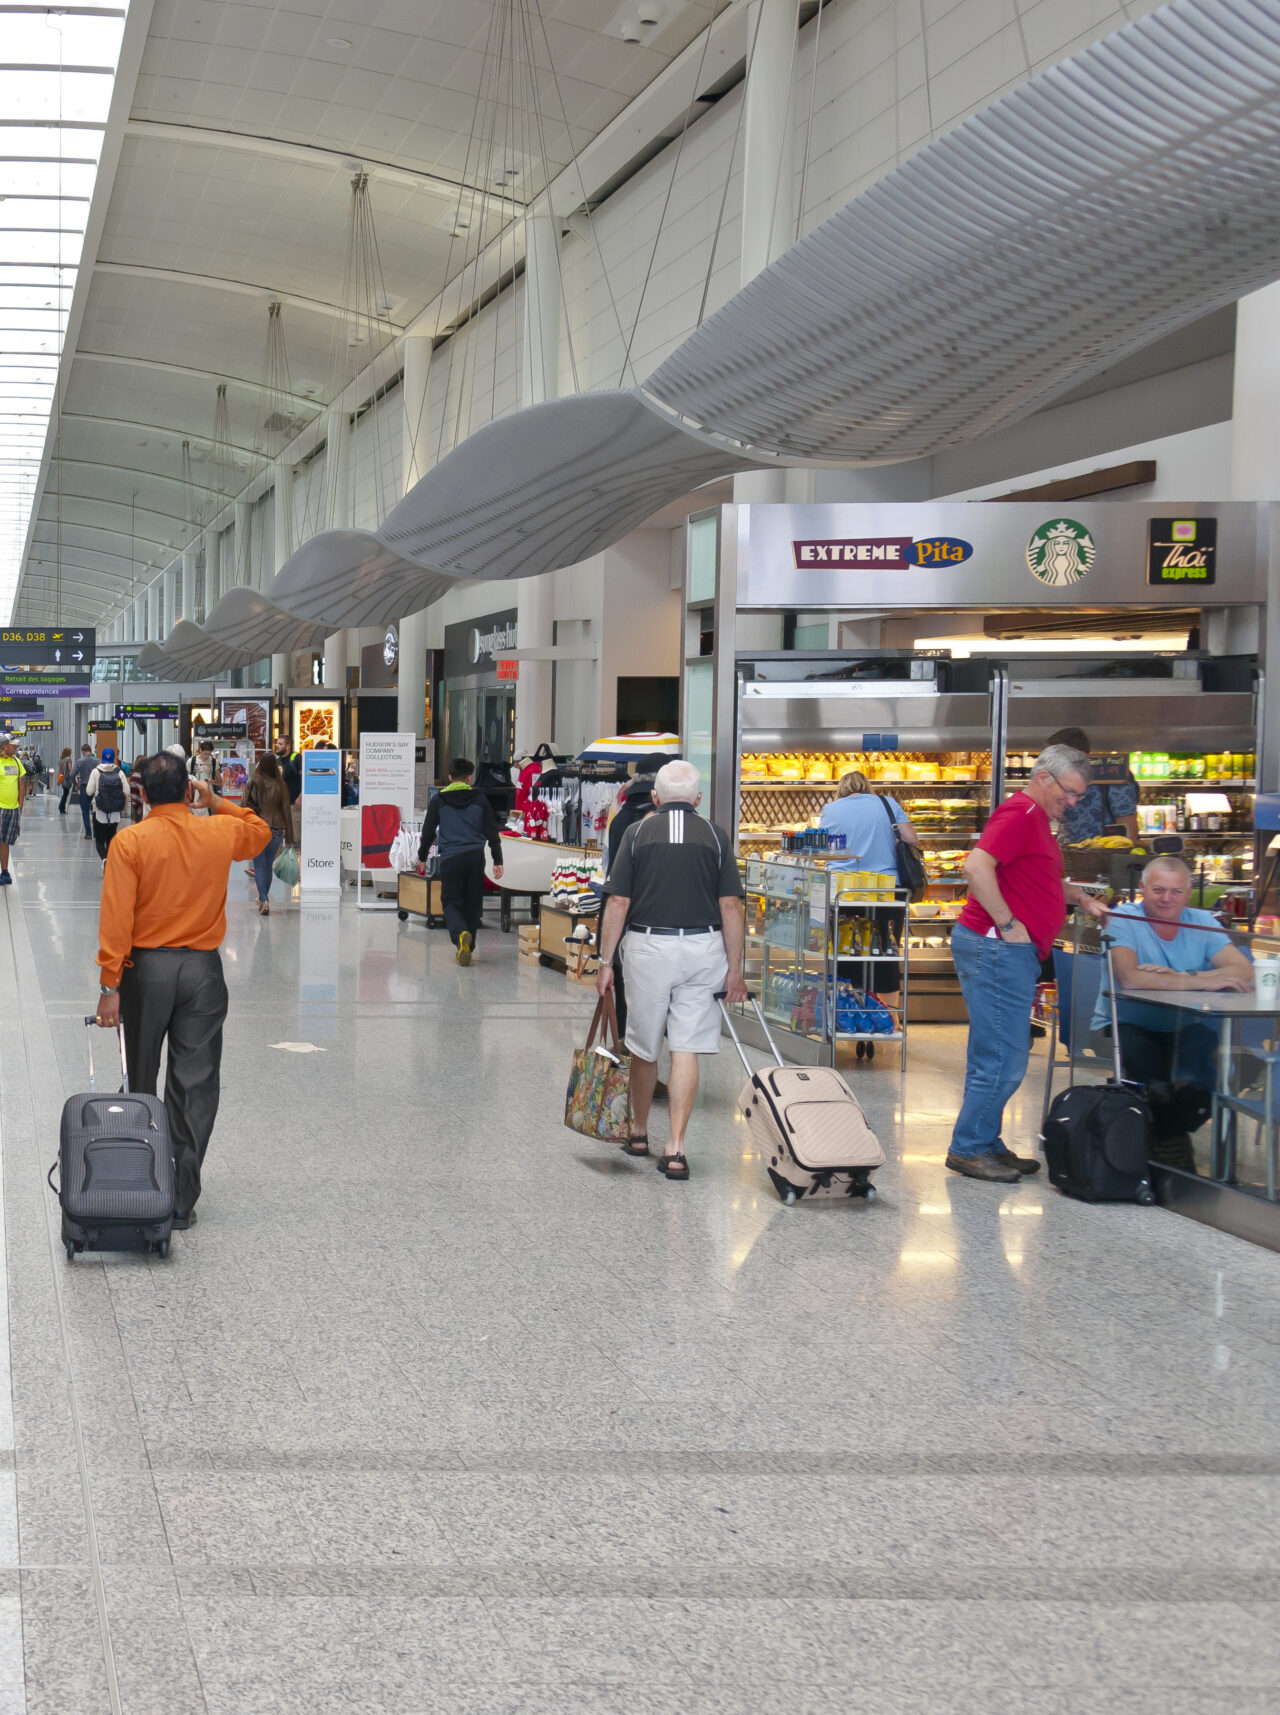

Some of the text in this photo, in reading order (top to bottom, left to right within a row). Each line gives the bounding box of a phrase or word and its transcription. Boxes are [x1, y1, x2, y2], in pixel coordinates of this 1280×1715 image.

[800, 541, 964, 565] EXTREME Pita
[1153, 542, 1214, 568] Thaï
[1161, 567, 1207, 581] express
[2, 632, 46, 642] D36, D38
[40, 675, 67, 683] bagages
[5, 687, 59, 696] Correspondances
[307, 857, 334, 868] iStore
